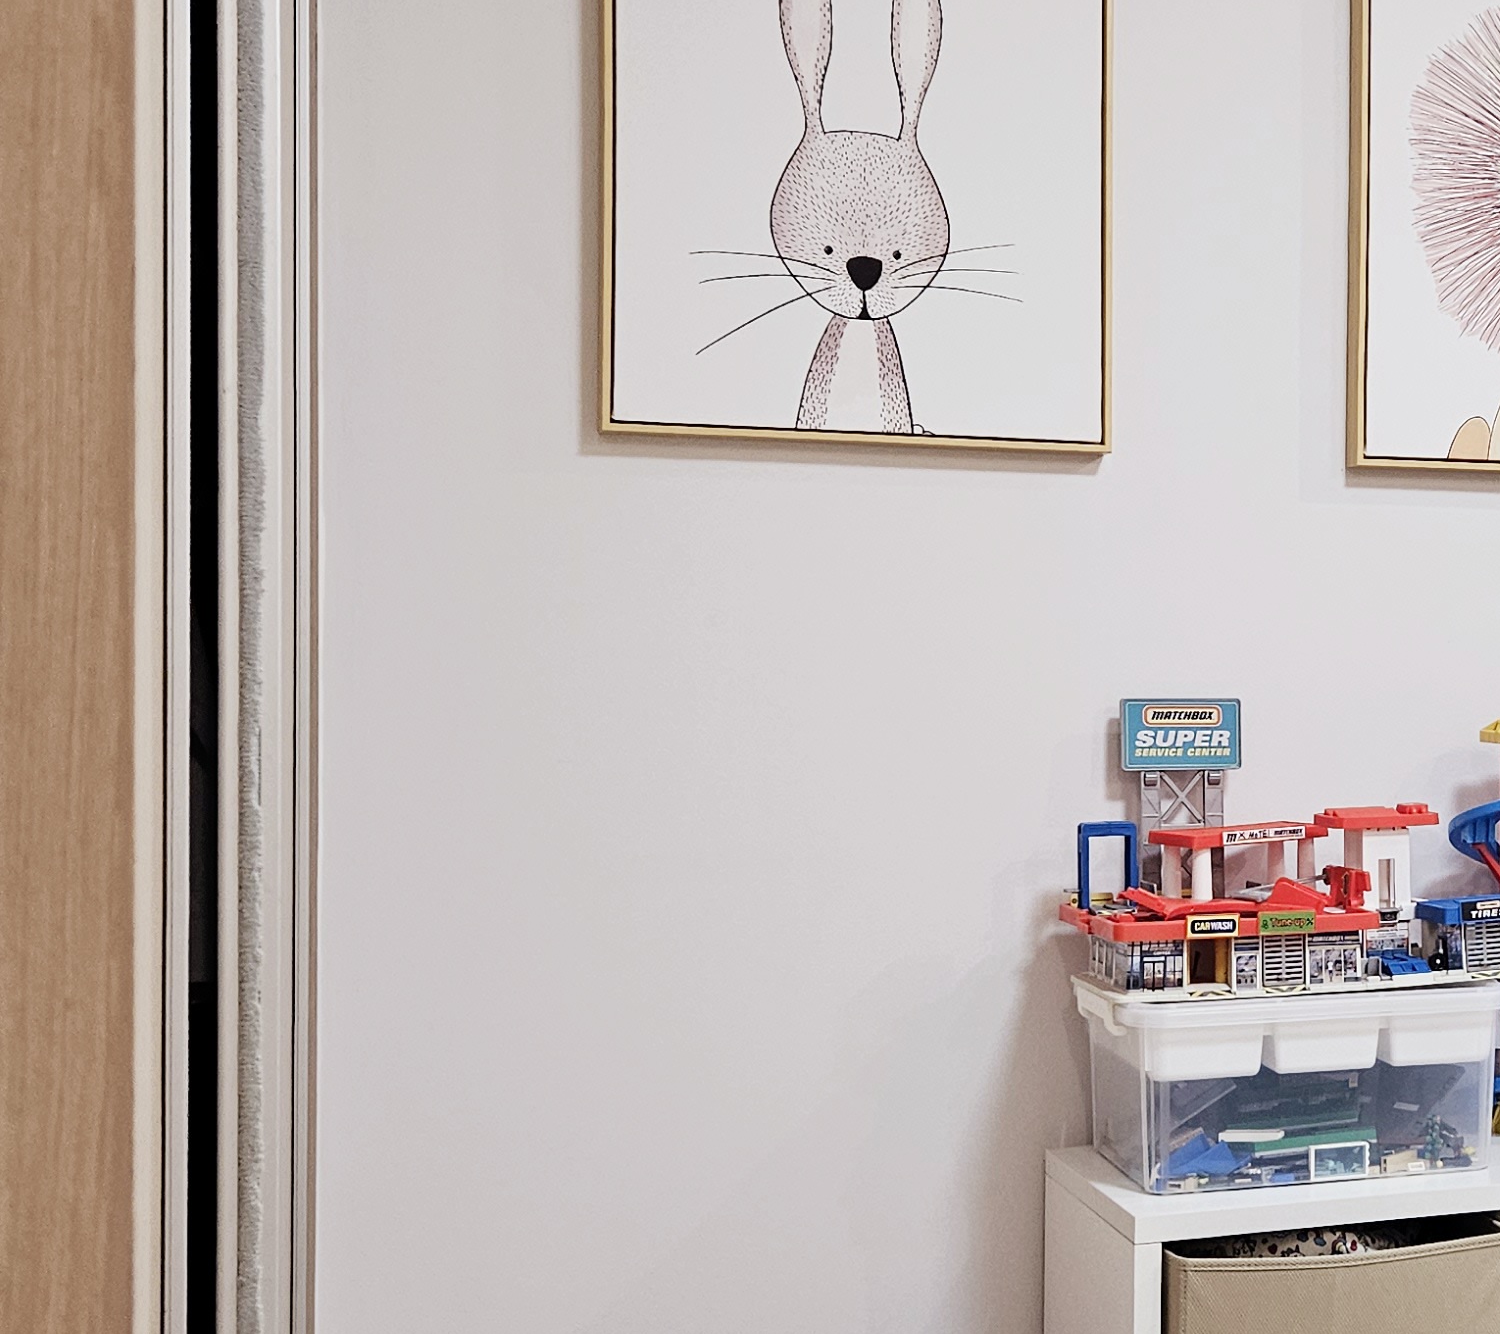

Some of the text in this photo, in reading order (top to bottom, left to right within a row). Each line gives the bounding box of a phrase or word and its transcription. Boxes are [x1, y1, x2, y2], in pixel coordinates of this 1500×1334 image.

[1151, 710, 1214, 721] MATCHBOX
[1135, 729, 1231, 747] SUPER
[1134, 747, 1231, 757] SERVICE CENTER
[1194, 920, 1233, 931] CAR WASH
[1270, 916, 1306, 928] Tune-up
